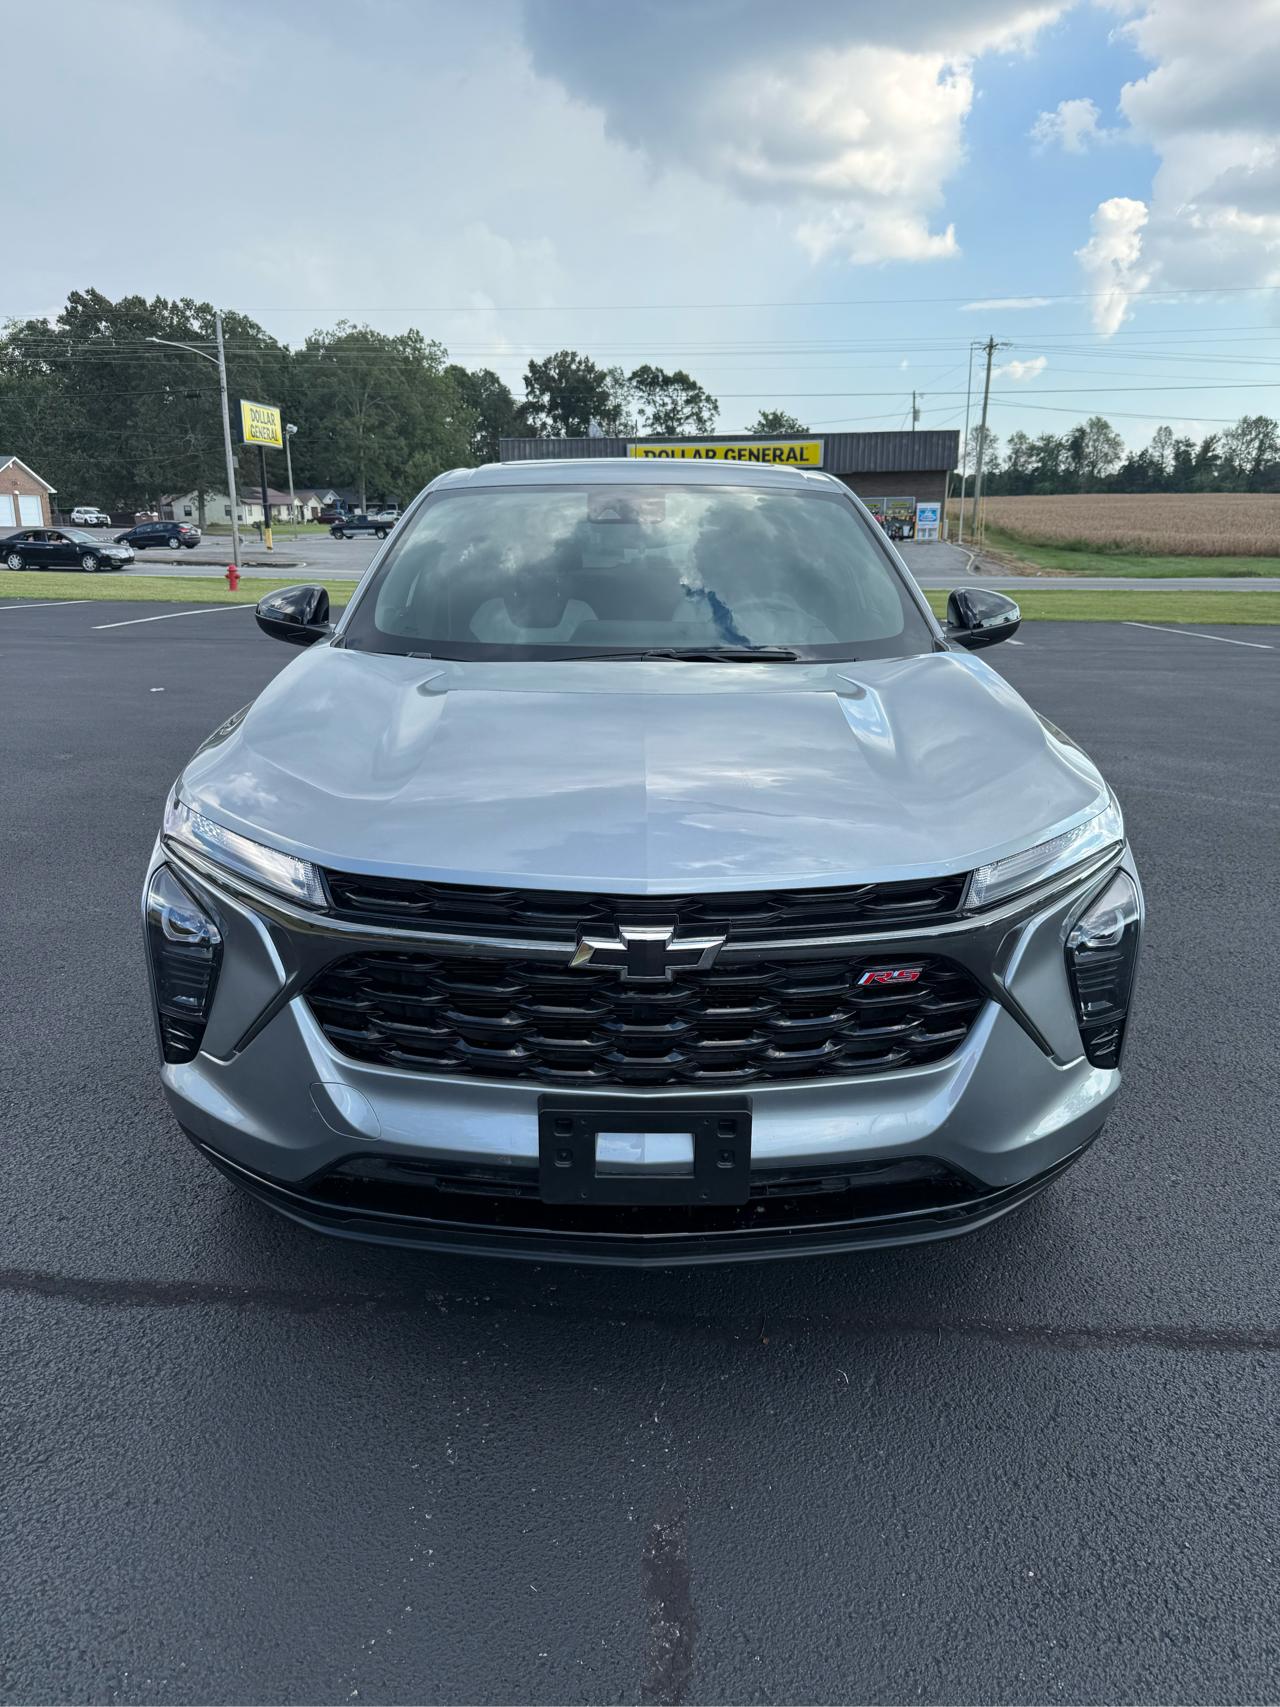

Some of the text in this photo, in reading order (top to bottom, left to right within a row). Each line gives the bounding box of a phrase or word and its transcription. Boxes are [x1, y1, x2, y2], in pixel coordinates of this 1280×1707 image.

[250, 409, 276, 425] DOLLAR
[250, 425, 279, 442] GENERAL
[724, 446, 809, 463] GENERAL
[857, 969, 923, 985] RS
